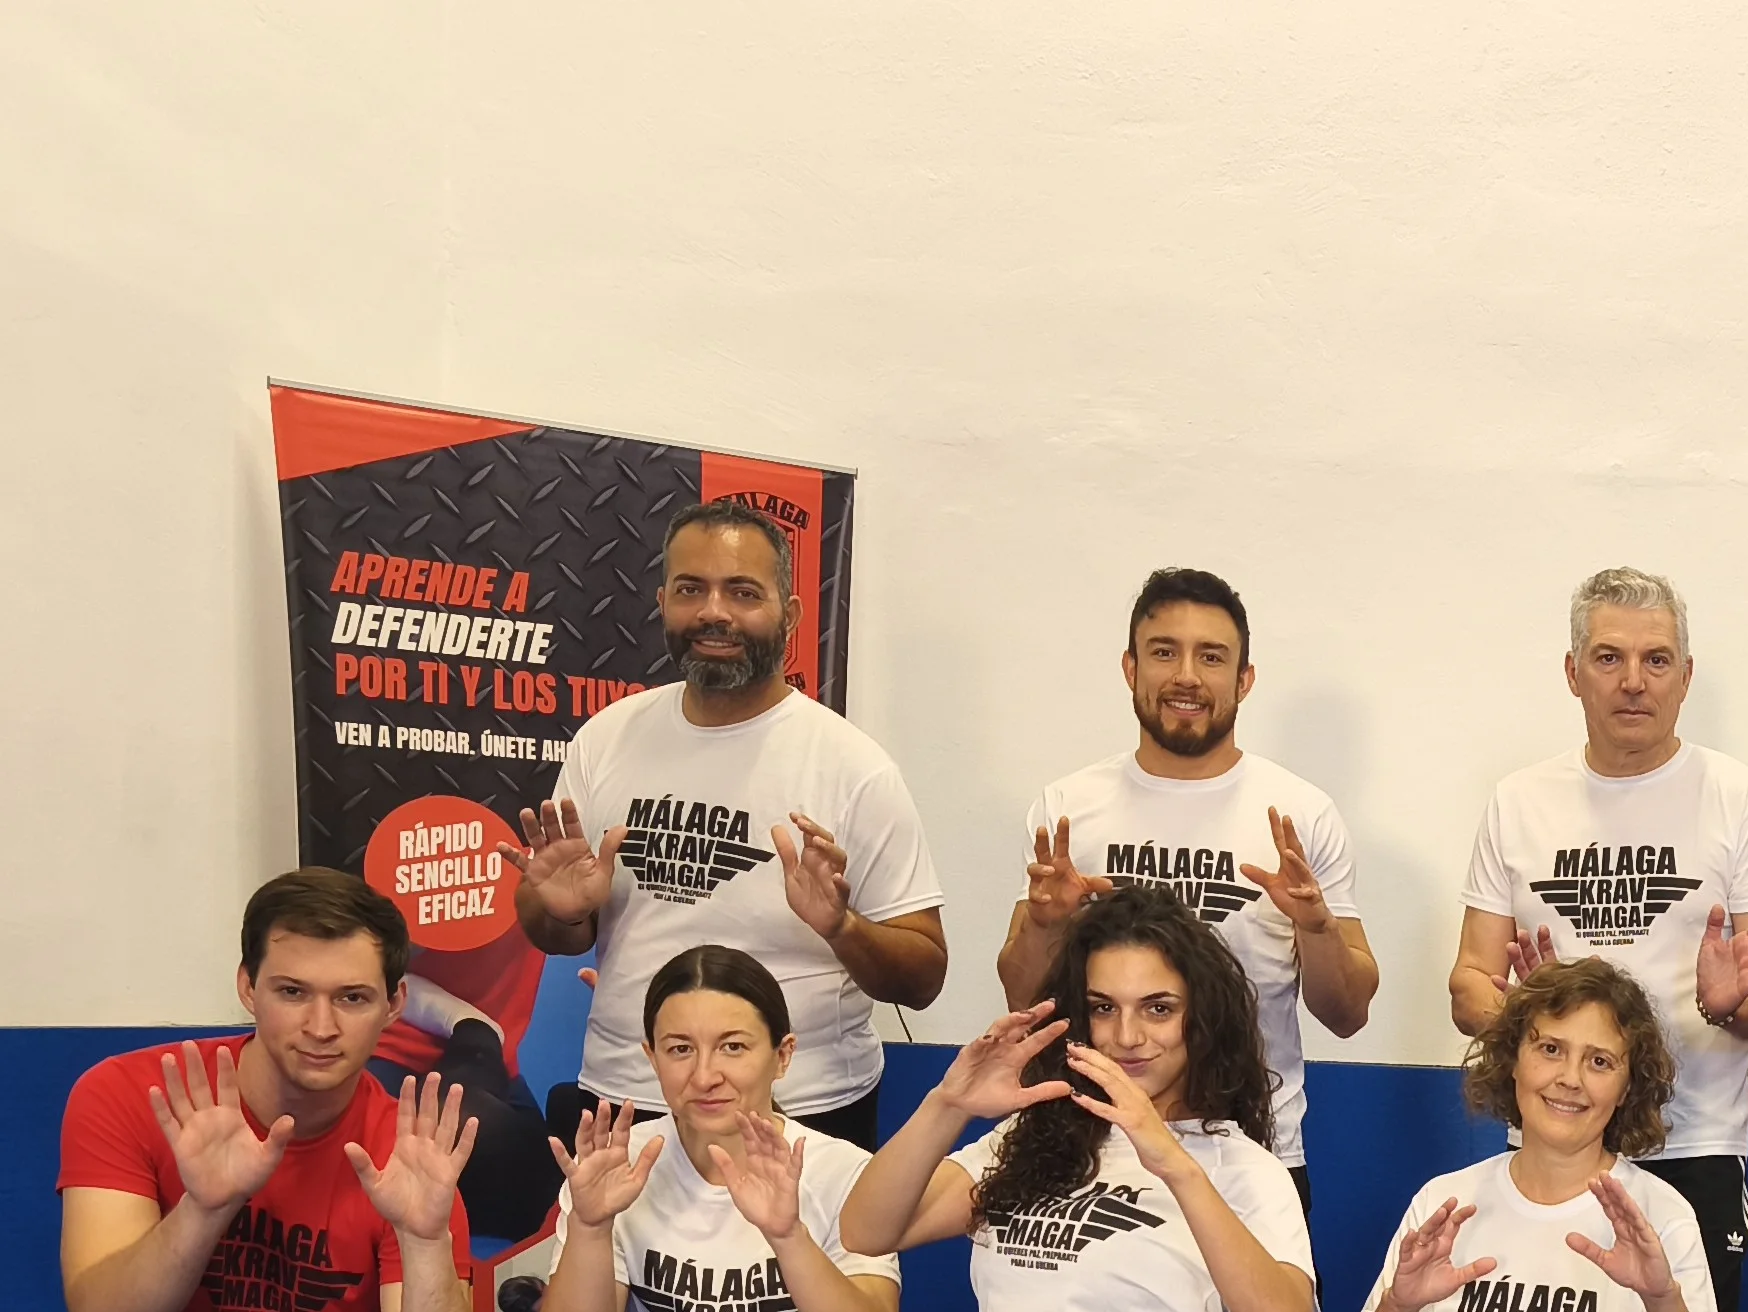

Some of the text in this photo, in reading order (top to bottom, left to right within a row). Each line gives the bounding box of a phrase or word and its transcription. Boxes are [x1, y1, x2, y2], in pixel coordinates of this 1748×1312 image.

[331, 550, 530, 612] APRENDE A
[331, 602, 554, 664] DEFENDERTE
[335, 653, 406, 700] POR
[419, 661, 448, 704] TI
[460, 665, 482, 707] Y
[494, 669, 556, 714] LOS
[335, 721, 372, 746] VEN
[377, 725, 391, 748] A
[397, 727, 475, 756] PROBAR.
[481, 729, 537, 760] ÚNETE
[626, 794, 750, 844] MÁLAGA
[400, 821, 483, 860] RÁPIDO
[646, 832, 715, 865] KRAV
[1554, 842, 1677, 877] MÁLAGA
[395, 852, 502, 894] SENCILLO
[646, 860, 706, 891] MAGA
[1107, 839, 1236, 882] MÁLAGA
[419, 886, 495, 925] EFICAZ
[1580, 878, 1646, 905] KRAV
[1582, 905, 1642, 930] MAGA
[1006, 1218, 1075, 1251] MAGA
[224, 1244, 300, 1292] KRAV
[644, 1249, 789, 1302] MÁLAGA
